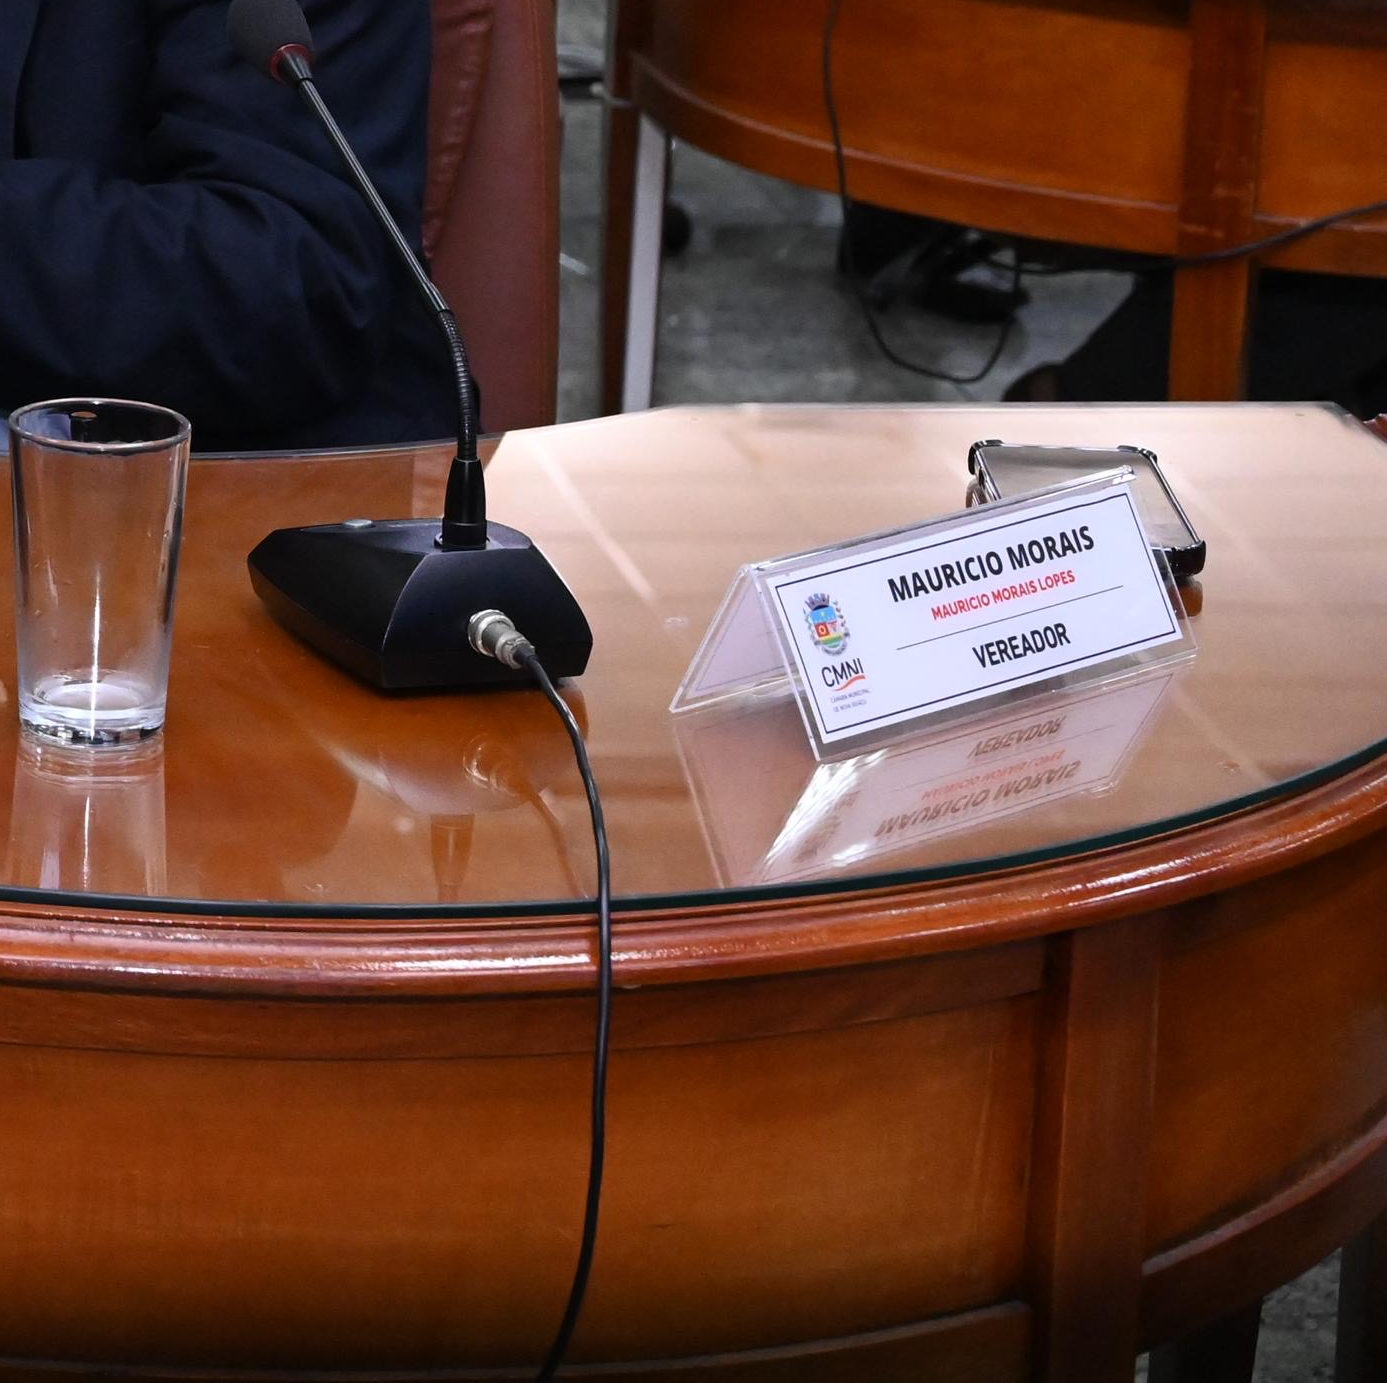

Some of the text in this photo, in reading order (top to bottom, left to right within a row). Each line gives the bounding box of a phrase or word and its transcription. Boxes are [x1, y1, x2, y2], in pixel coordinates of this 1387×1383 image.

[888, 525, 1095, 603] MAURICIO MORAIS
[931, 569, 1076, 621] MAURICIO MORAIS LOPES
[972, 622, 1071, 669] VEREADOR
[821, 658, 864, 687] CMNI
